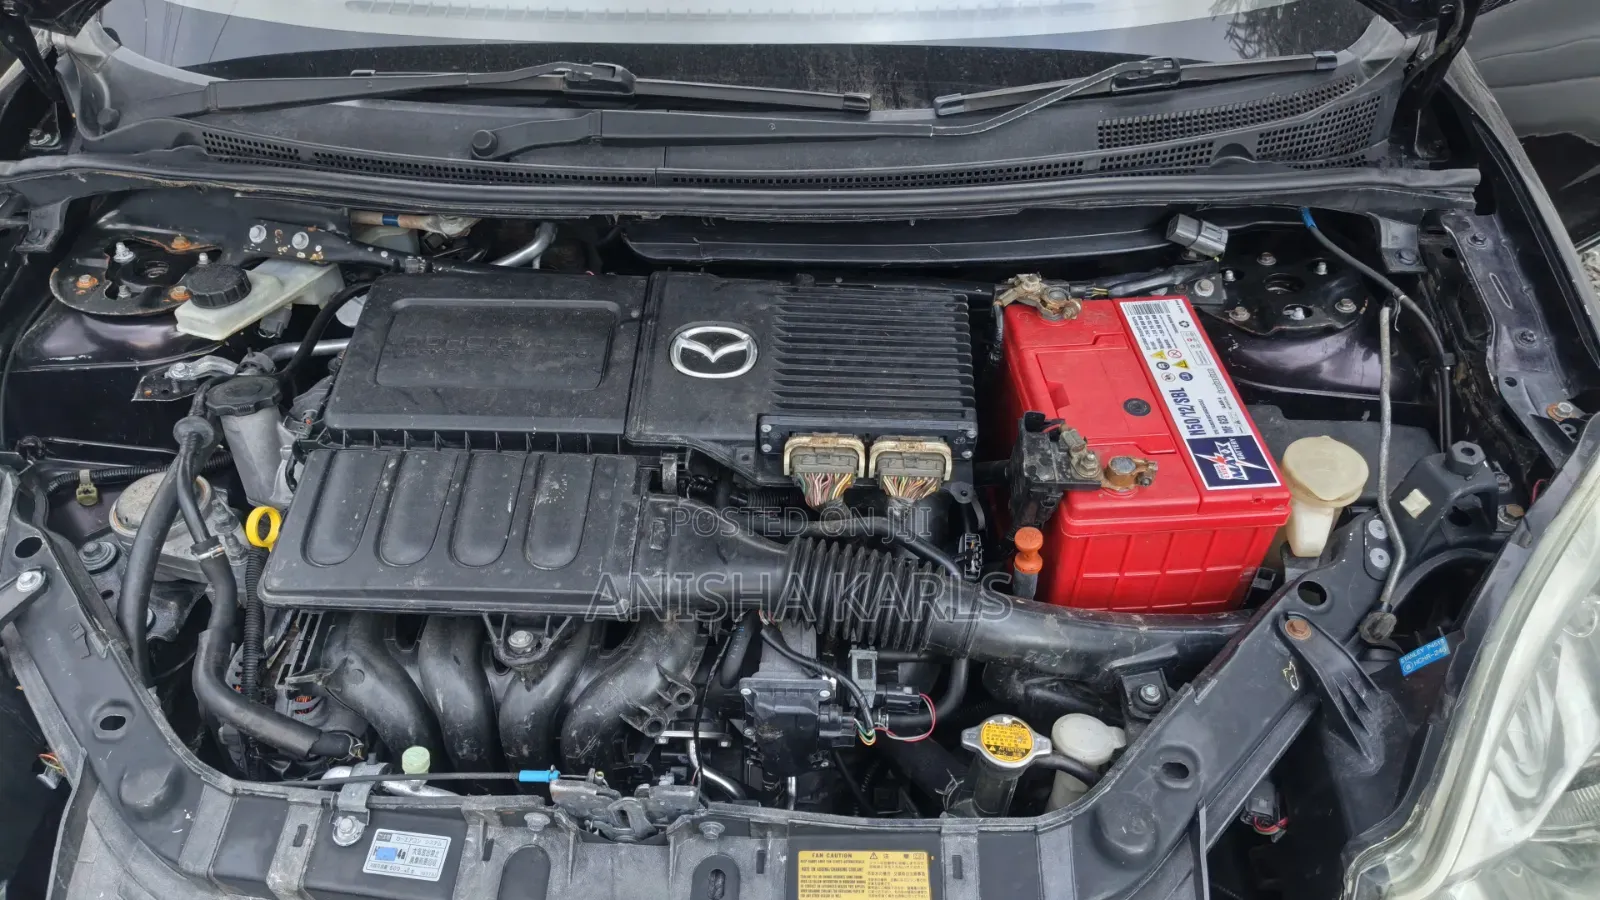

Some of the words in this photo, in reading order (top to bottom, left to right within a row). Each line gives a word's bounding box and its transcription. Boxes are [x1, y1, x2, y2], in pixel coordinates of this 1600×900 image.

[1168, 388, 1206, 436] N50/12/SBL
[1216, 442, 1247, 480] MAXX
[1230, 438, 1245, 460] BATTERY
